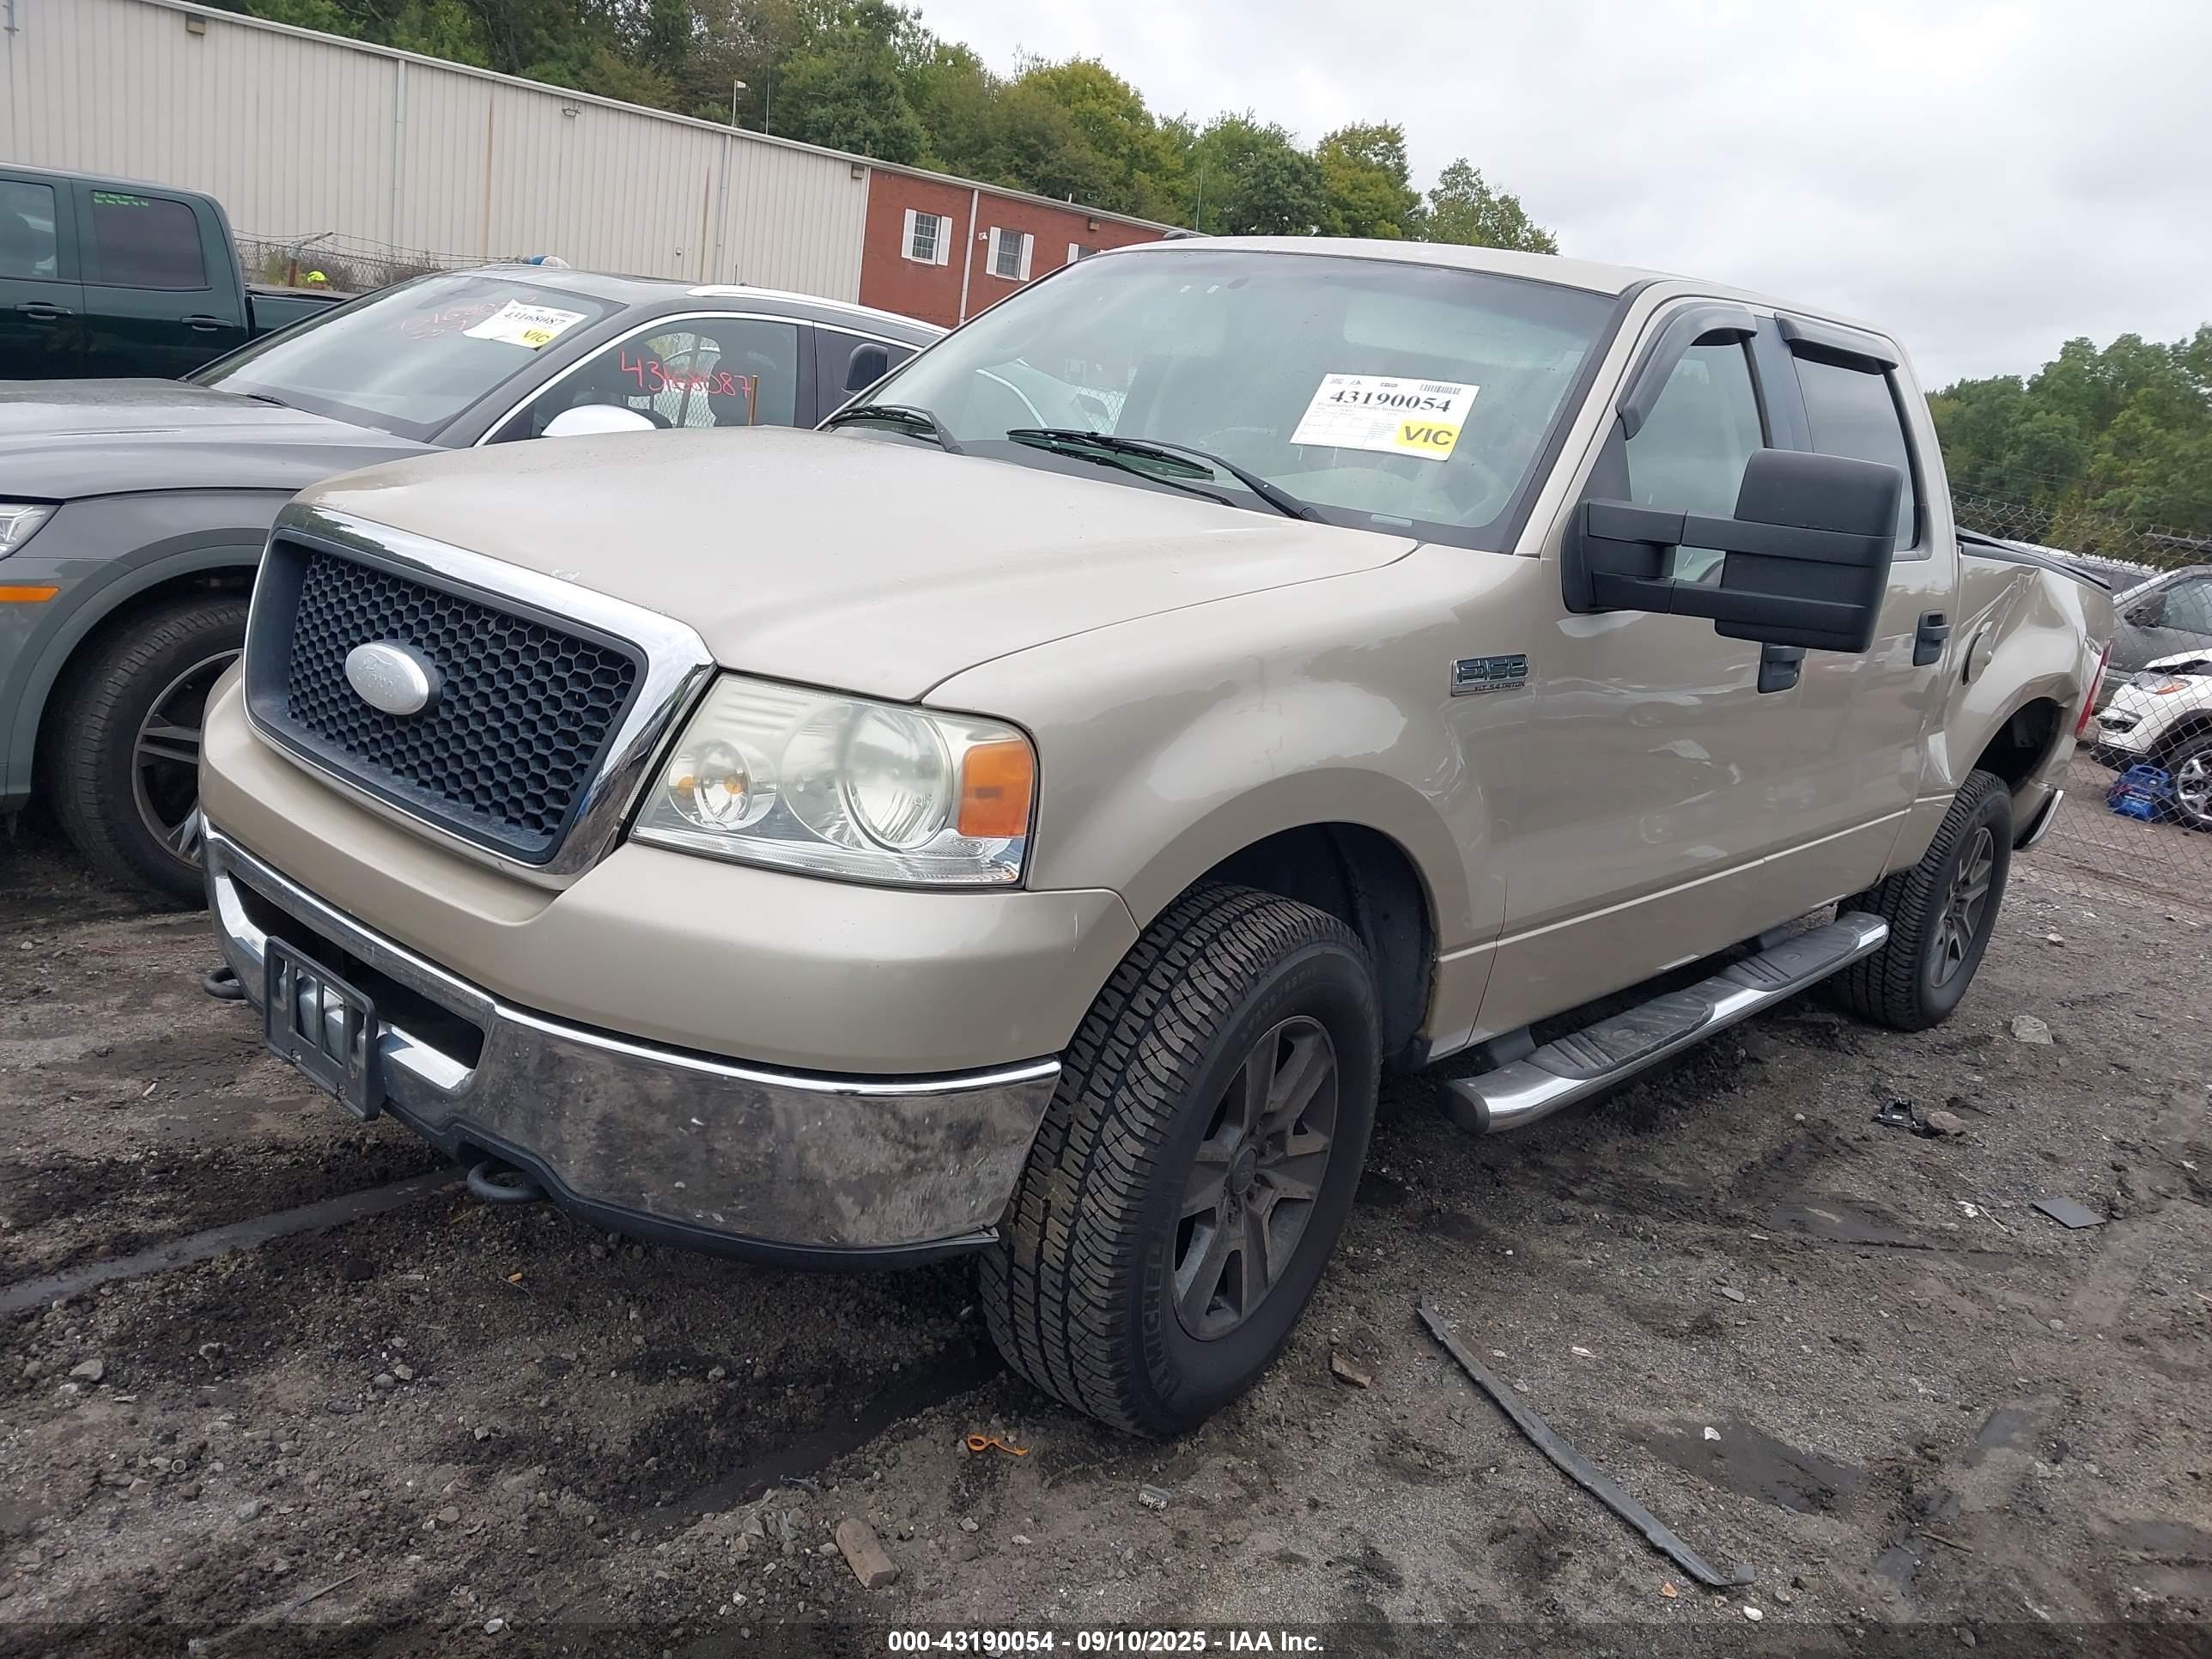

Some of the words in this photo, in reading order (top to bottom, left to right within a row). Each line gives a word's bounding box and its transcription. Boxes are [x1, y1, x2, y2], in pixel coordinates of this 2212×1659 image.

[523, 330, 550, 343] VIC
[1330, 389, 1452, 413] 43190054
[1405, 425, 1453, 446] VIC
